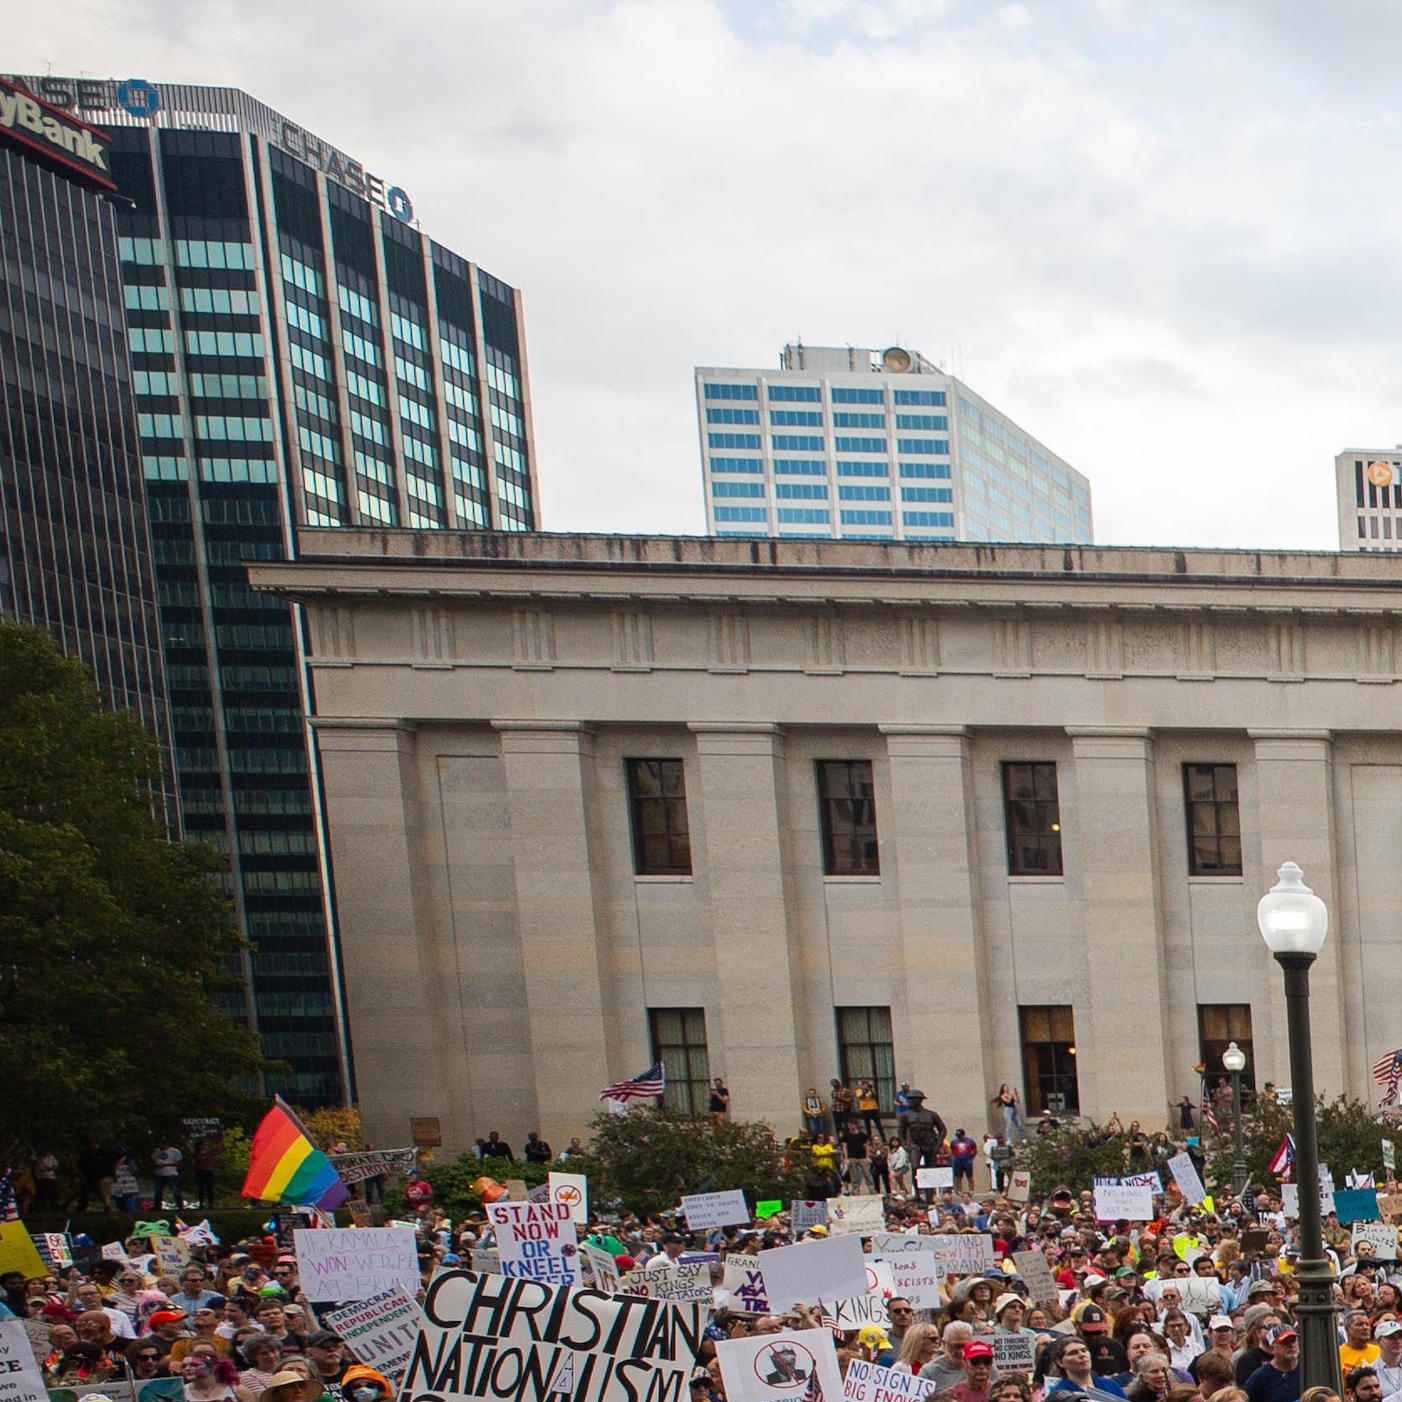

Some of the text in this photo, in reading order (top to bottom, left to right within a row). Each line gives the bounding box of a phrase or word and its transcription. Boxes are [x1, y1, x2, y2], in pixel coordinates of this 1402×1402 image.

[0, 88, 107, 171] yBank
[280, 123, 384, 205] CHASE
[494, 1202, 572, 1225] STAND
[511, 1221, 561, 1242] NOW
[521, 1239, 551, 1259] OR
[949, 1247, 985, 1258] WITH
[310, 1256, 349, 1277] WON
[502, 1256, 576, 1277] KNEEL
[630, 1263, 704, 1284] JUST SAY
[655, 1277, 696, 1292] KINGS
[332, 1286, 397, 1322] DEMOCRAT
[335, 1295, 408, 1333] REPUBLICAN
[835, 1295, 893, 1325] KINGS
[342, 1303, 413, 1342] INDEPENDENT
[423, 1269, 702, 1365] CHRISTIAN
[995, 1352, 1007, 1361] NO
[844, 1379, 866, 1400] BIG
[876, 1369, 935, 1397] SIGN IS
